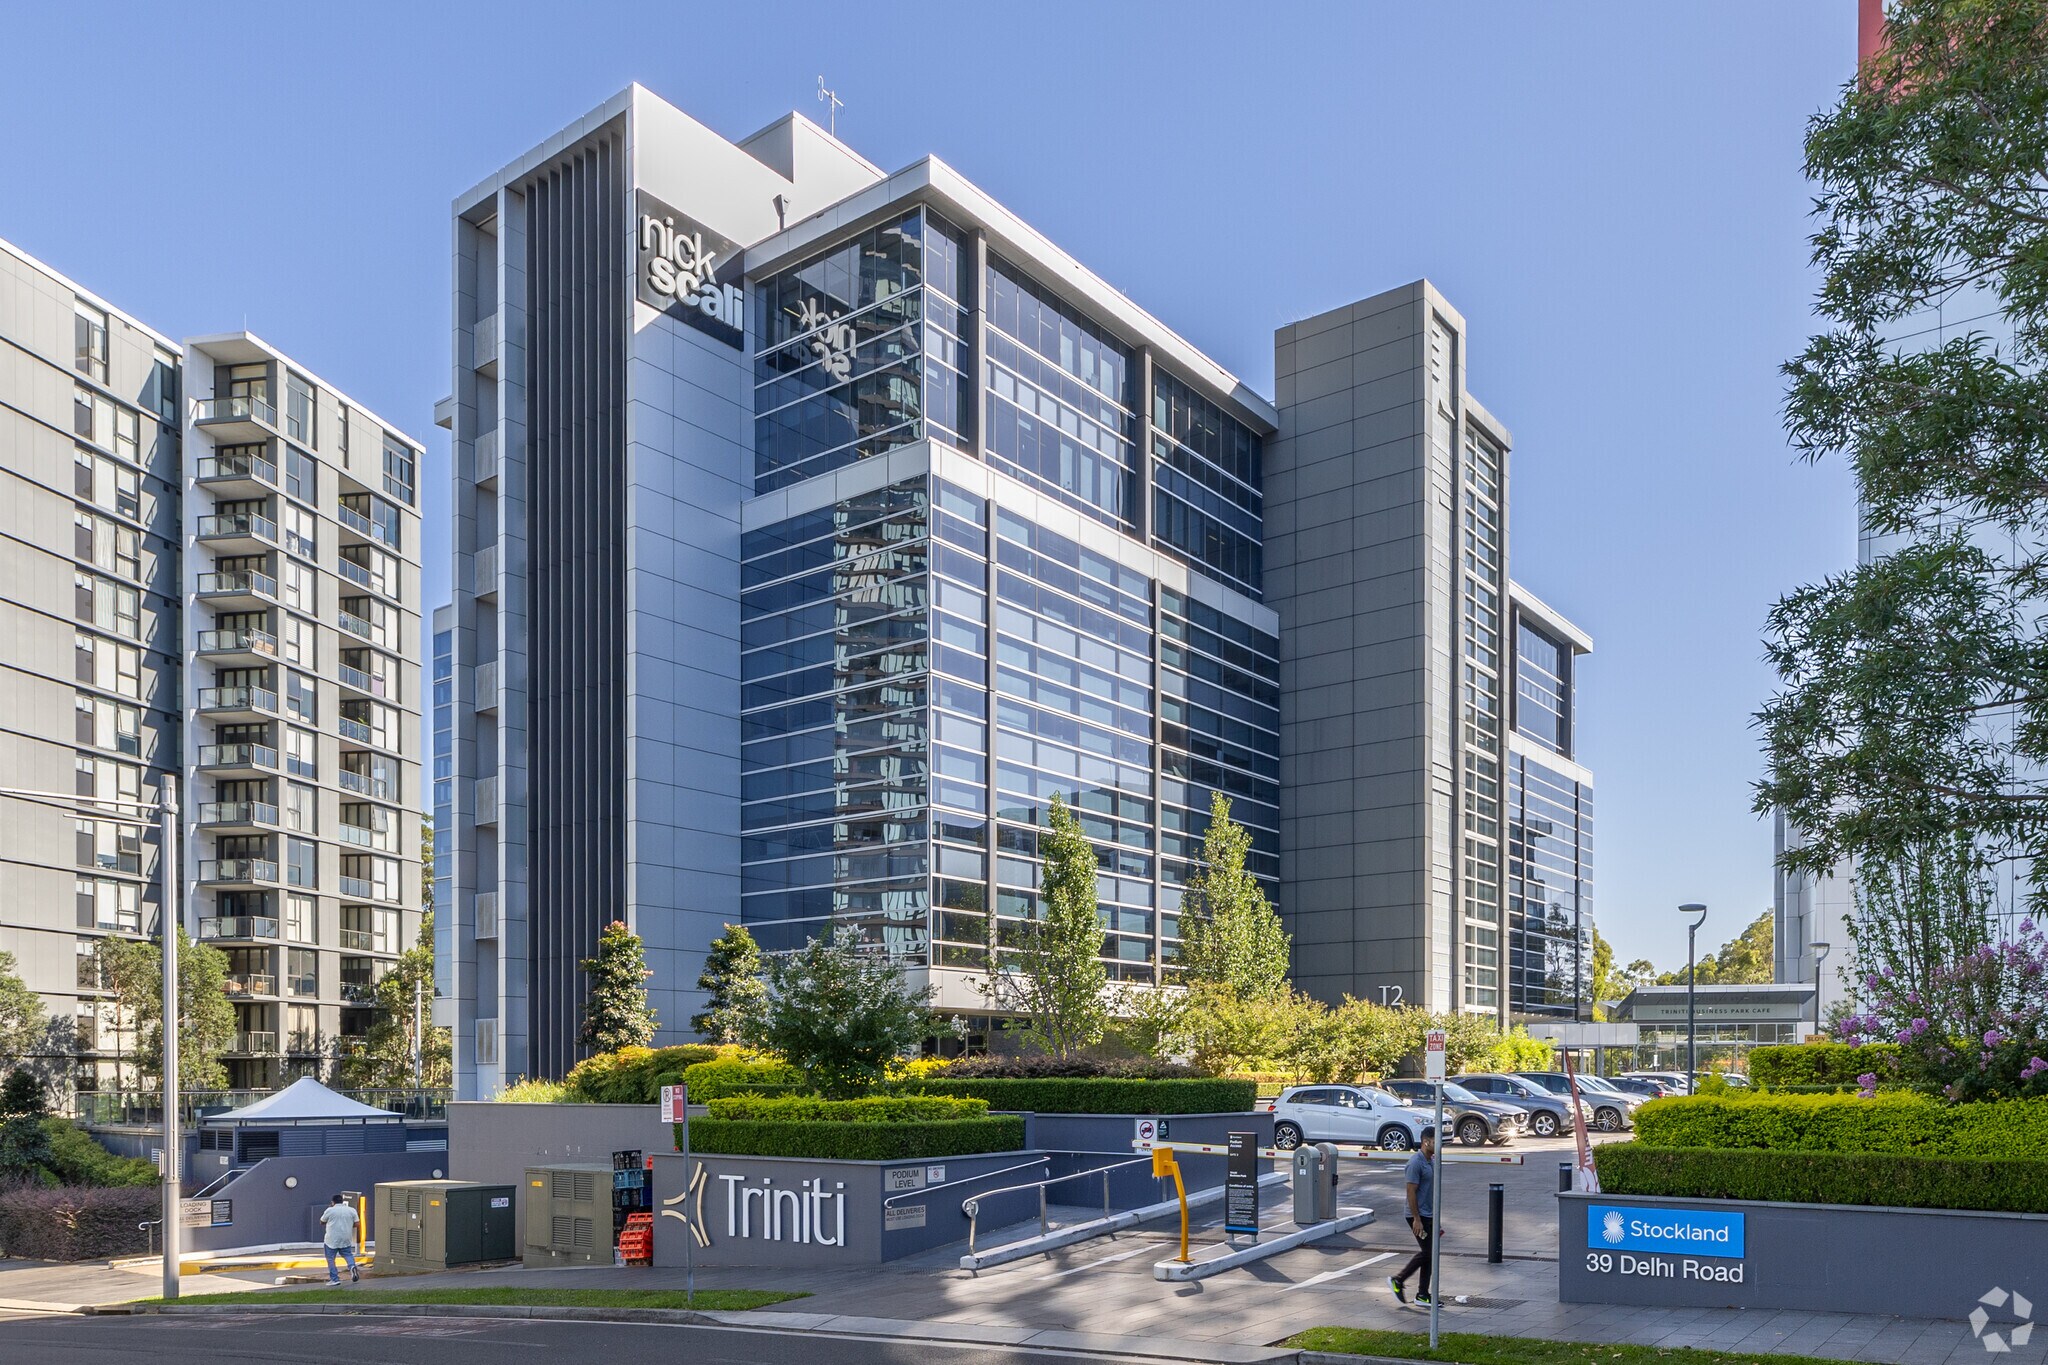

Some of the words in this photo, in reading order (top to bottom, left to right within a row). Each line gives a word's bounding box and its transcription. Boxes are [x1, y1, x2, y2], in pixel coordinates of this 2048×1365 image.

[641, 214, 717, 284] nick
[648, 256, 743, 332] scali
[1378, 985, 1403, 1006] T2
[892, 1170, 919, 1178] PODIUM
[895, 1180, 915, 1188] LEVEL
[718, 1174, 845, 1247] Triniti
[896, 1206, 924, 1215] DELIVERIES
[1630, 1220, 1729, 1243] Stockland
[1586, 1253, 1613, 1273] 39
[1620, 1254, 1675, 1278] Delhi
[1683, 1259, 1744, 1283] Road
